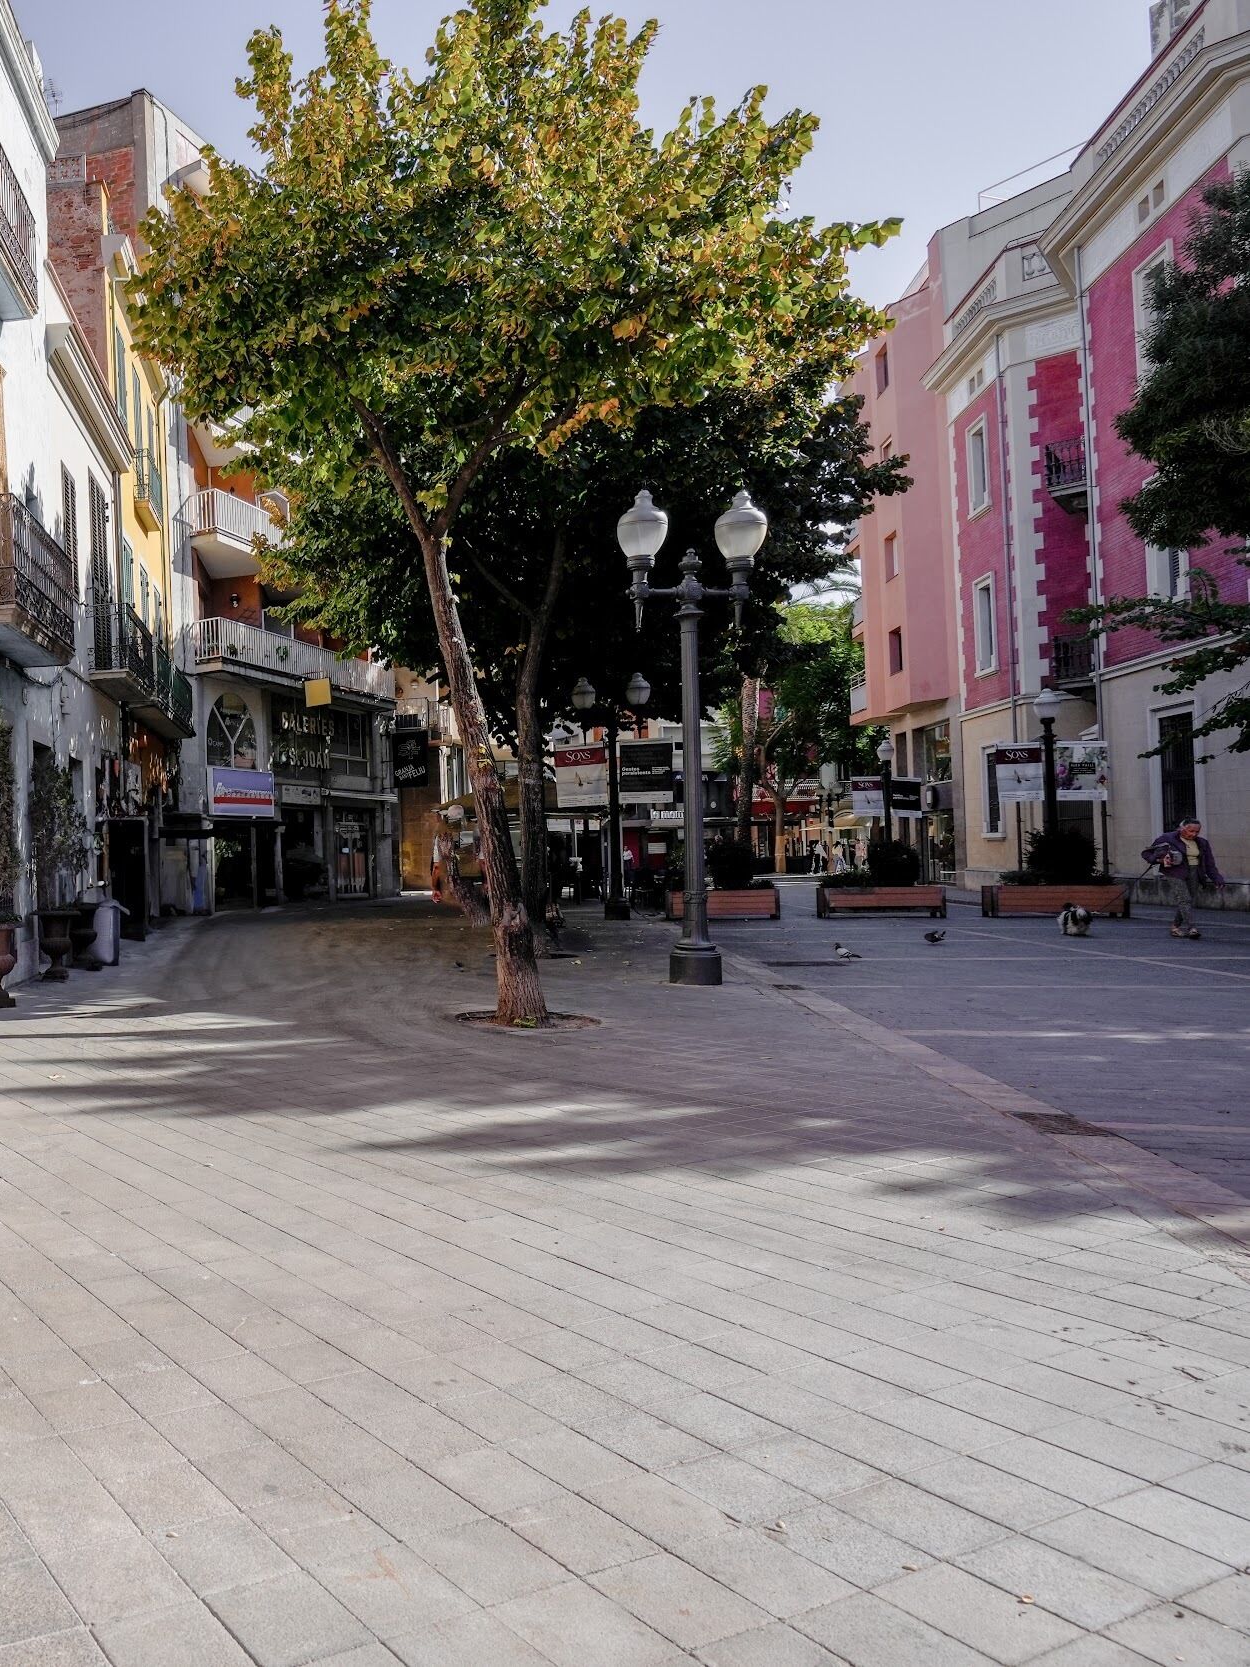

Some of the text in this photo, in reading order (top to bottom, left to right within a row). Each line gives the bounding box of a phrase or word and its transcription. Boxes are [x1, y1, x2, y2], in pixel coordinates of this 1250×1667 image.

[281, 711, 335, 737] GALERIES
[302, 750, 331, 769] JOAN
[394, 763, 415, 777] GRANJA
[409, 765, 426, 779] FELIU
